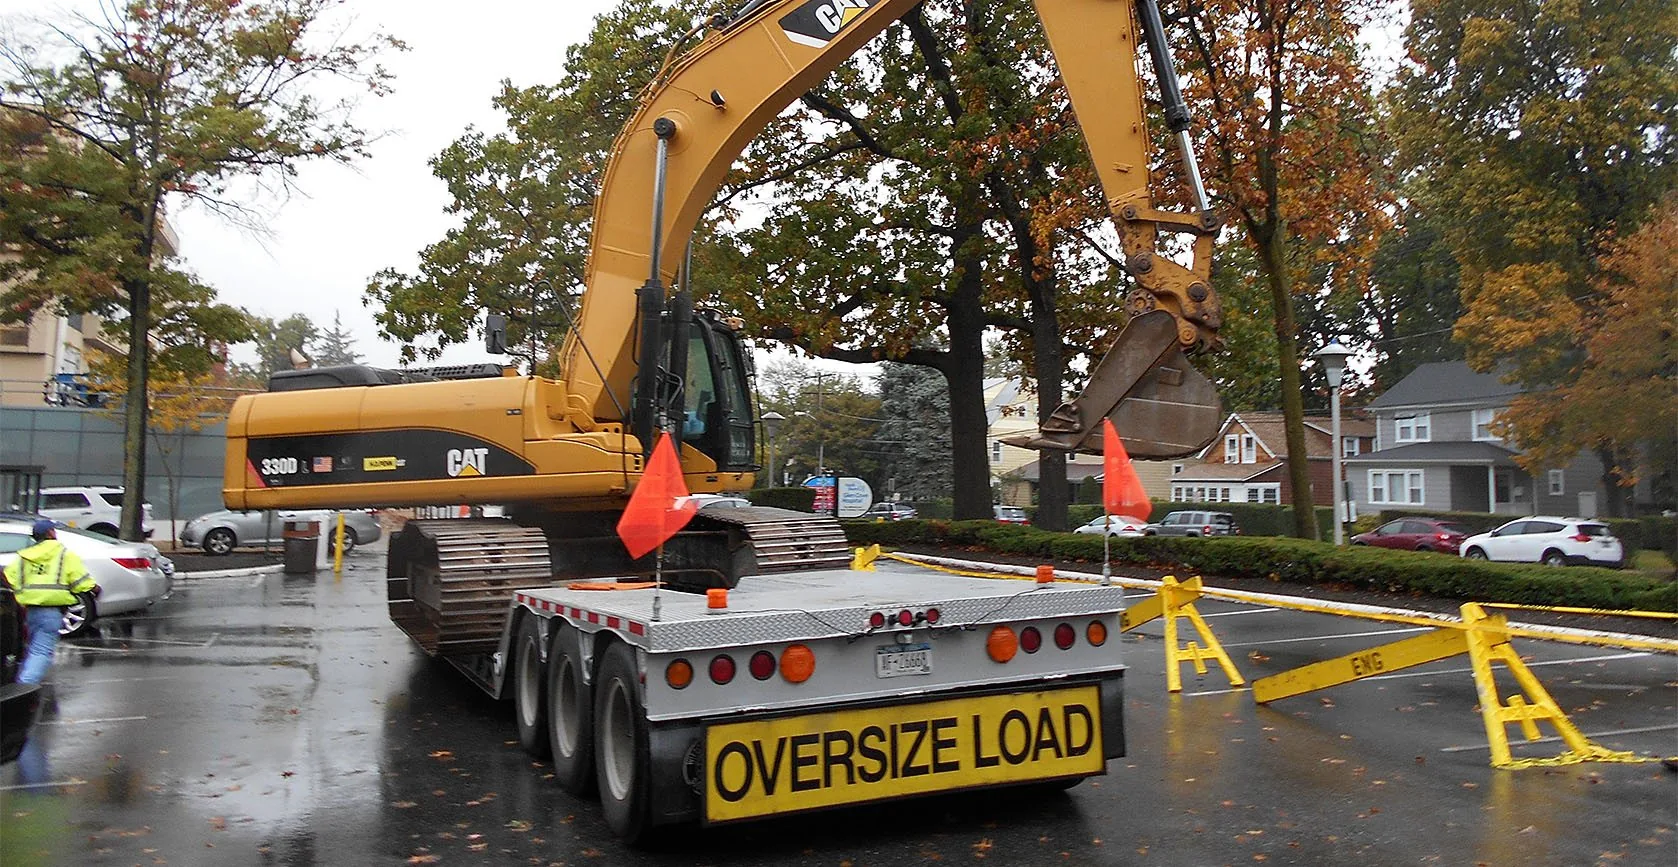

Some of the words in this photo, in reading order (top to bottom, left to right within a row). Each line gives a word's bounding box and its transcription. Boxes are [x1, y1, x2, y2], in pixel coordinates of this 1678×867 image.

[261, 457, 298, 475] 330D
[447, 448, 489, 476] CAT
[1351, 652, 1383, 676] ENG
[715, 717, 960, 802] OVERSIZE
[972, 704, 1093, 768] LOAD
